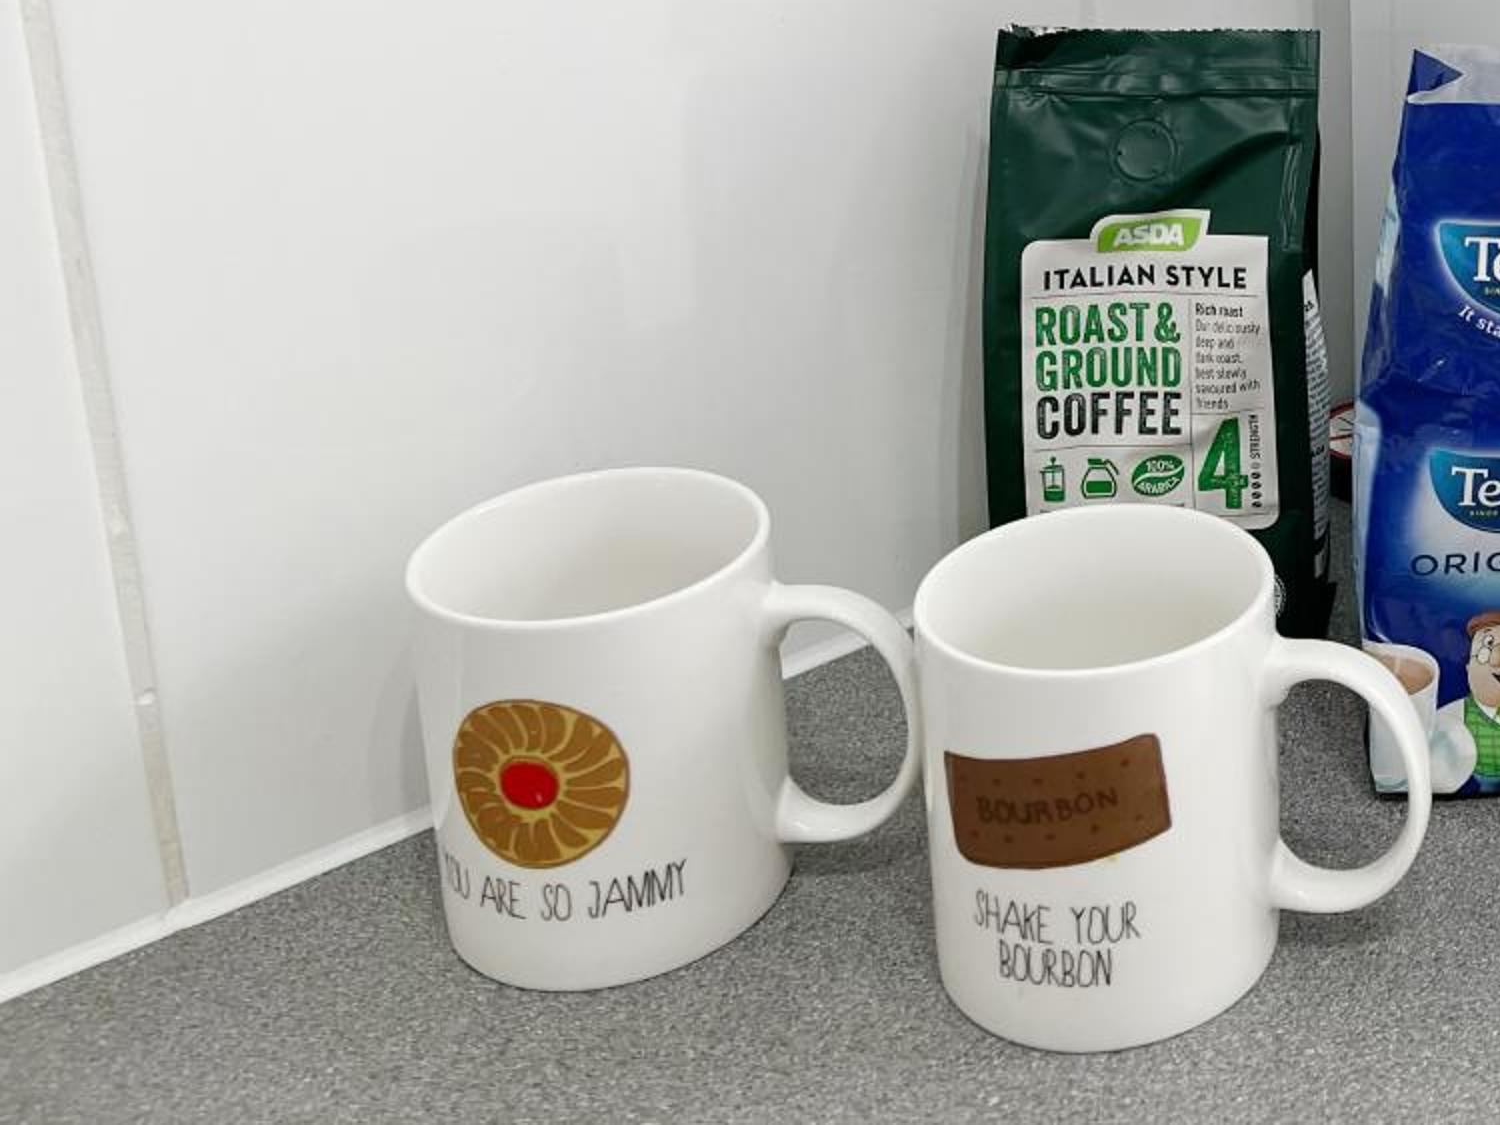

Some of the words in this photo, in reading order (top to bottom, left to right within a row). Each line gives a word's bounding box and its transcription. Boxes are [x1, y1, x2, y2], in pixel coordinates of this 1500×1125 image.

[1113, 223, 1185, 247] ASDA
[1044, 264, 1155, 291] ITALIAN
[1165, 265, 1247, 289] STYLE
[1458, 305, 1473, 322] It
[1035, 346, 1182, 392] GROUND
[1036, 391, 1182, 440] COFFEE
[1198, 416, 1249, 509] 4
[975, 787, 1119, 825] BOURBON
[479, 874, 527, 920] ARE
[540, 882, 573, 922] SO
[587, 857, 688, 920] JAMMY
[973, 887, 1054, 946] SHAKE
[1070, 901, 1142, 945] YOUR
[998, 938, 1113, 989] BOURBON
